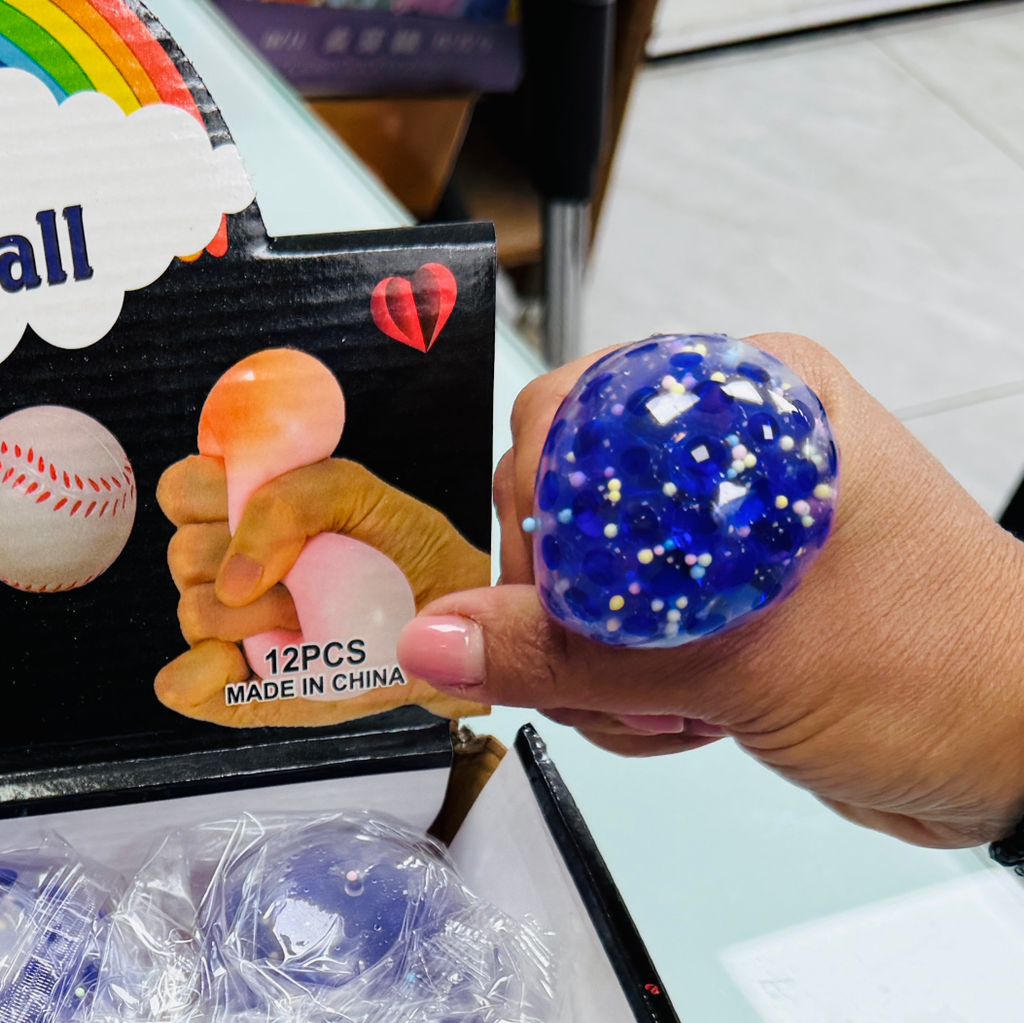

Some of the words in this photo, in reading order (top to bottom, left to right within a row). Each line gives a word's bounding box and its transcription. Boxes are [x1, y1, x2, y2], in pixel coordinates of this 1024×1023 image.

[265, 638, 367, 675] 12PCS
[226, 679, 295, 705] MADE
[302, 676, 324, 696] IN
[332, 666, 406, 692] CHINA
